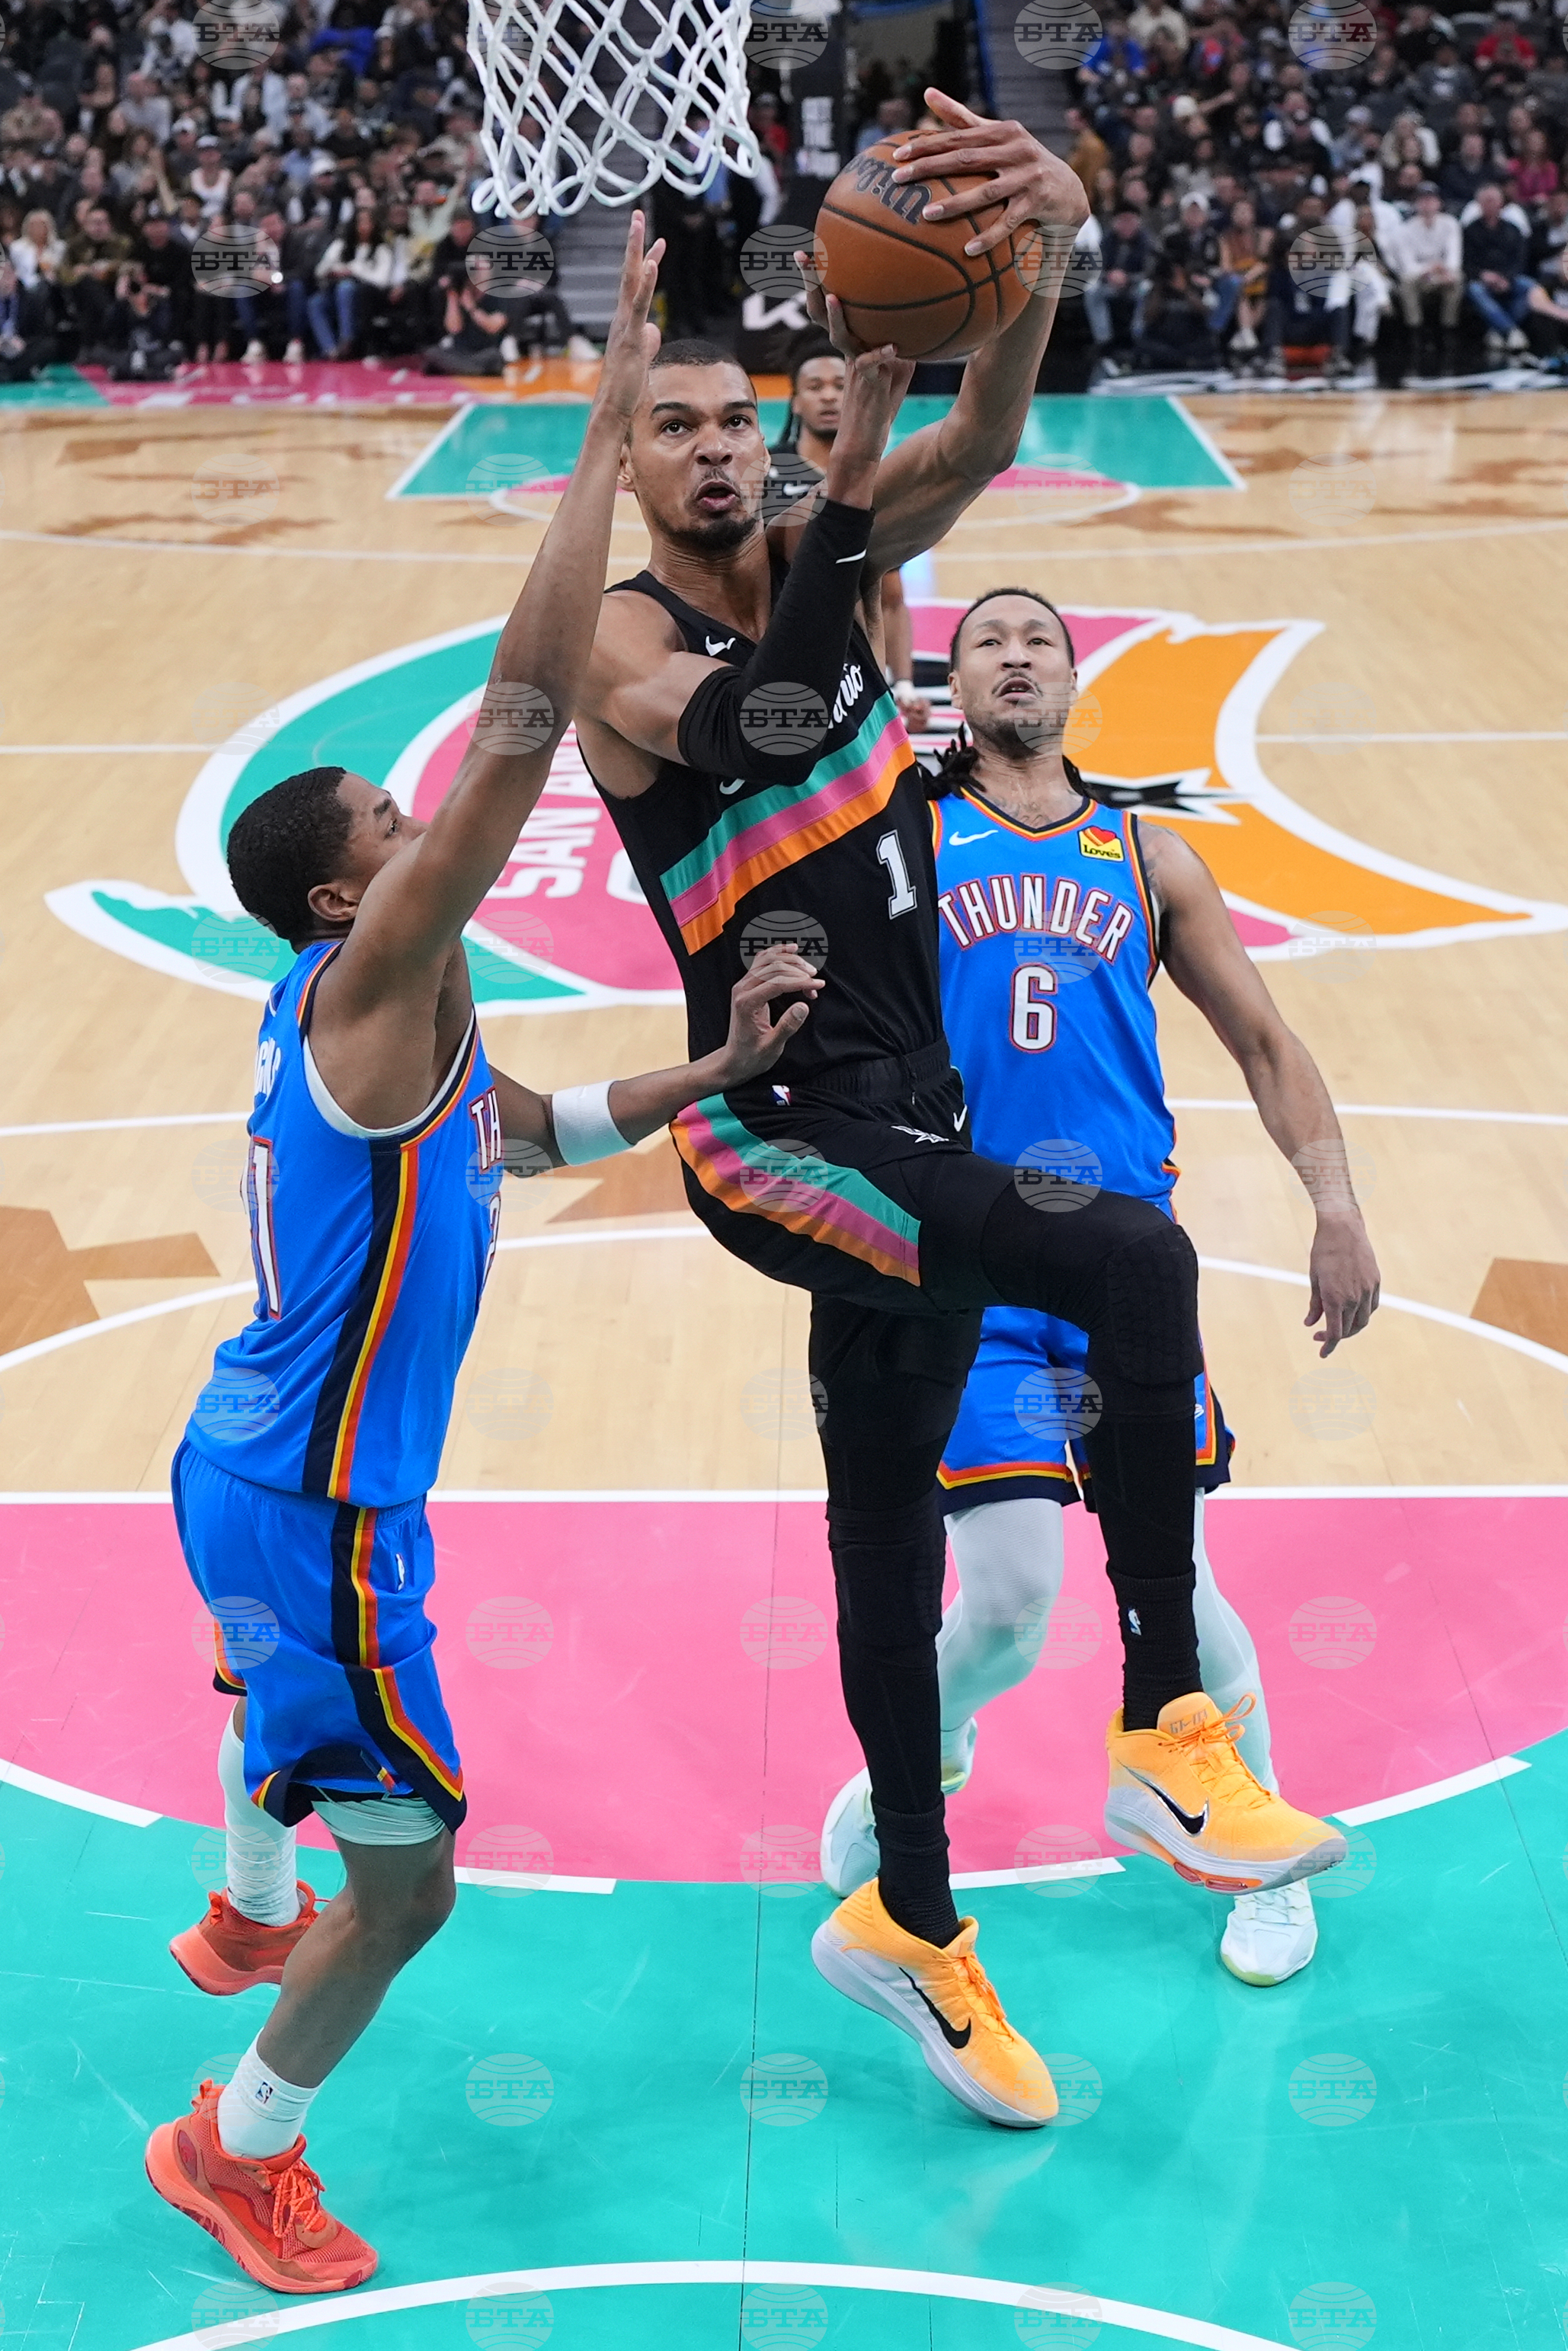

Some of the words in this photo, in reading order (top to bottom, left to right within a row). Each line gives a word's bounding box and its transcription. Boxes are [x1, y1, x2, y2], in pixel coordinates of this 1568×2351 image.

[875, 830, 917, 920] 1
[938, 873, 1133, 964] THUNDER
[1009, 963, 1058, 1054] 6
